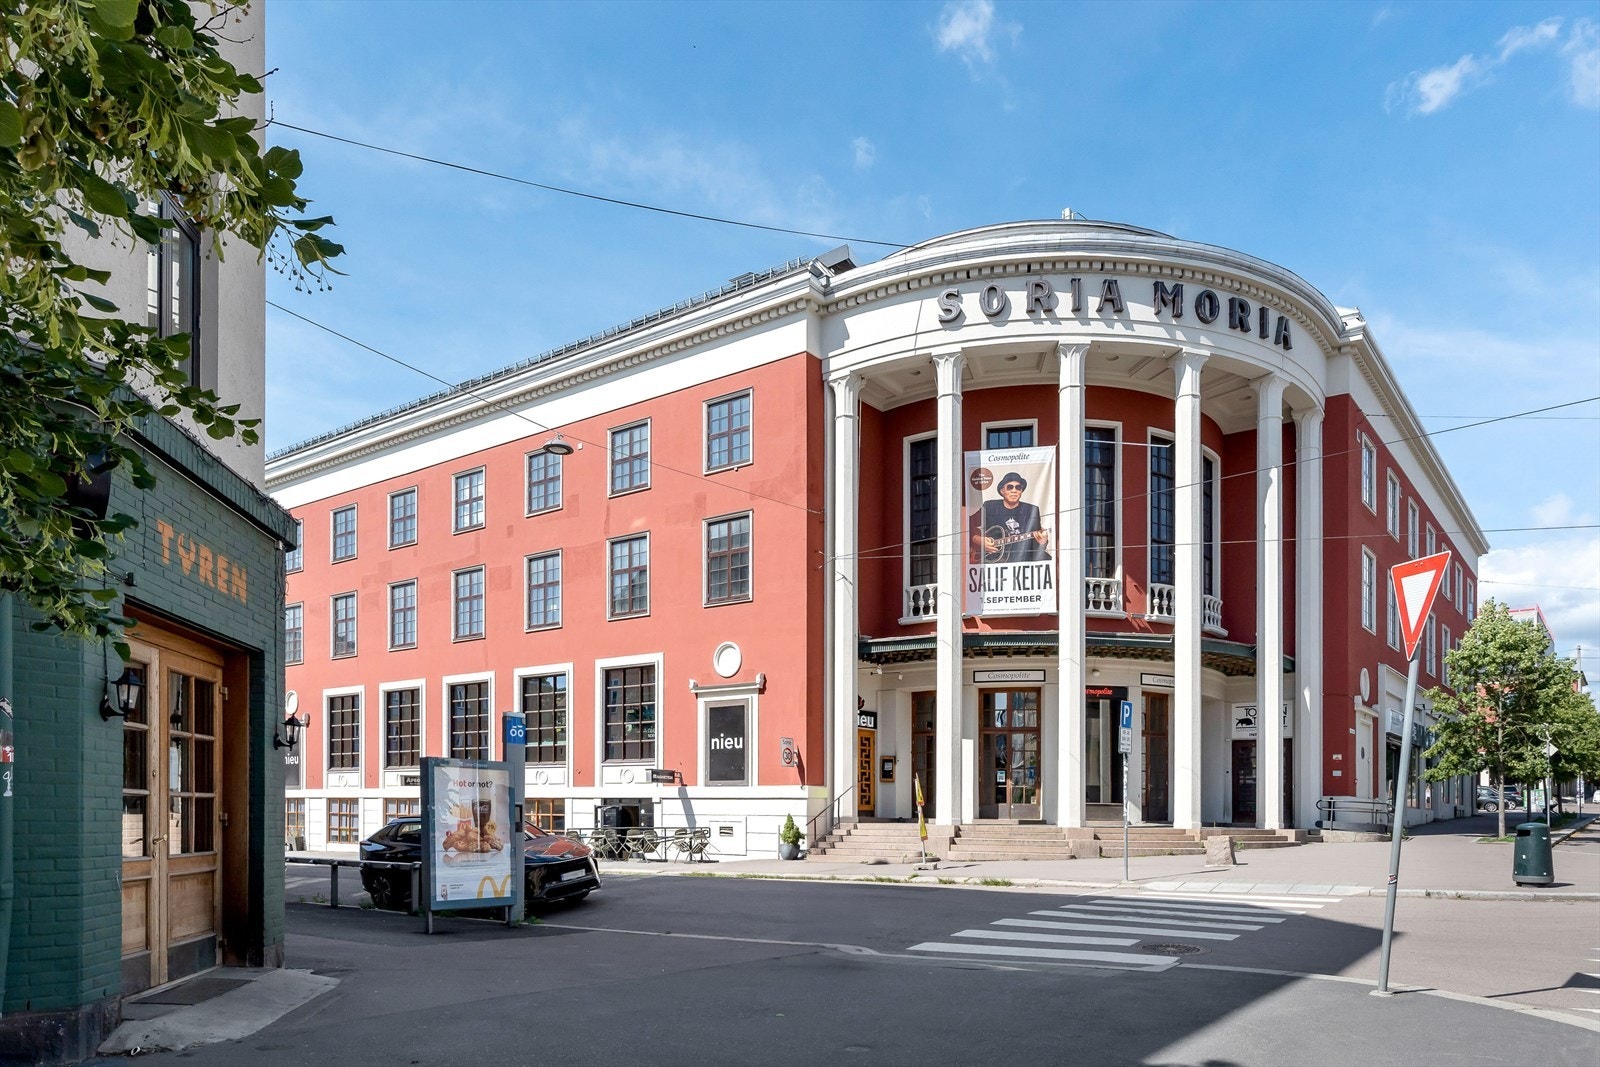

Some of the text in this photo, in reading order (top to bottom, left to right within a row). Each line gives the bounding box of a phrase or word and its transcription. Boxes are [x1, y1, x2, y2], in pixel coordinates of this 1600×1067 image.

[938, 277, 1293, 351] SORIA MORIA
[988, 453, 1031, 463] Cosmopolite
[157, 517, 248, 607] TYREN
[969, 563, 1053, 593] SALIF KEITA
[987, 671, 1031, 680] Cosmopolite
[1123, 704, 1131, 725] P
[711, 733, 743, 750] nieu
[453, 779, 467, 788] Hot
